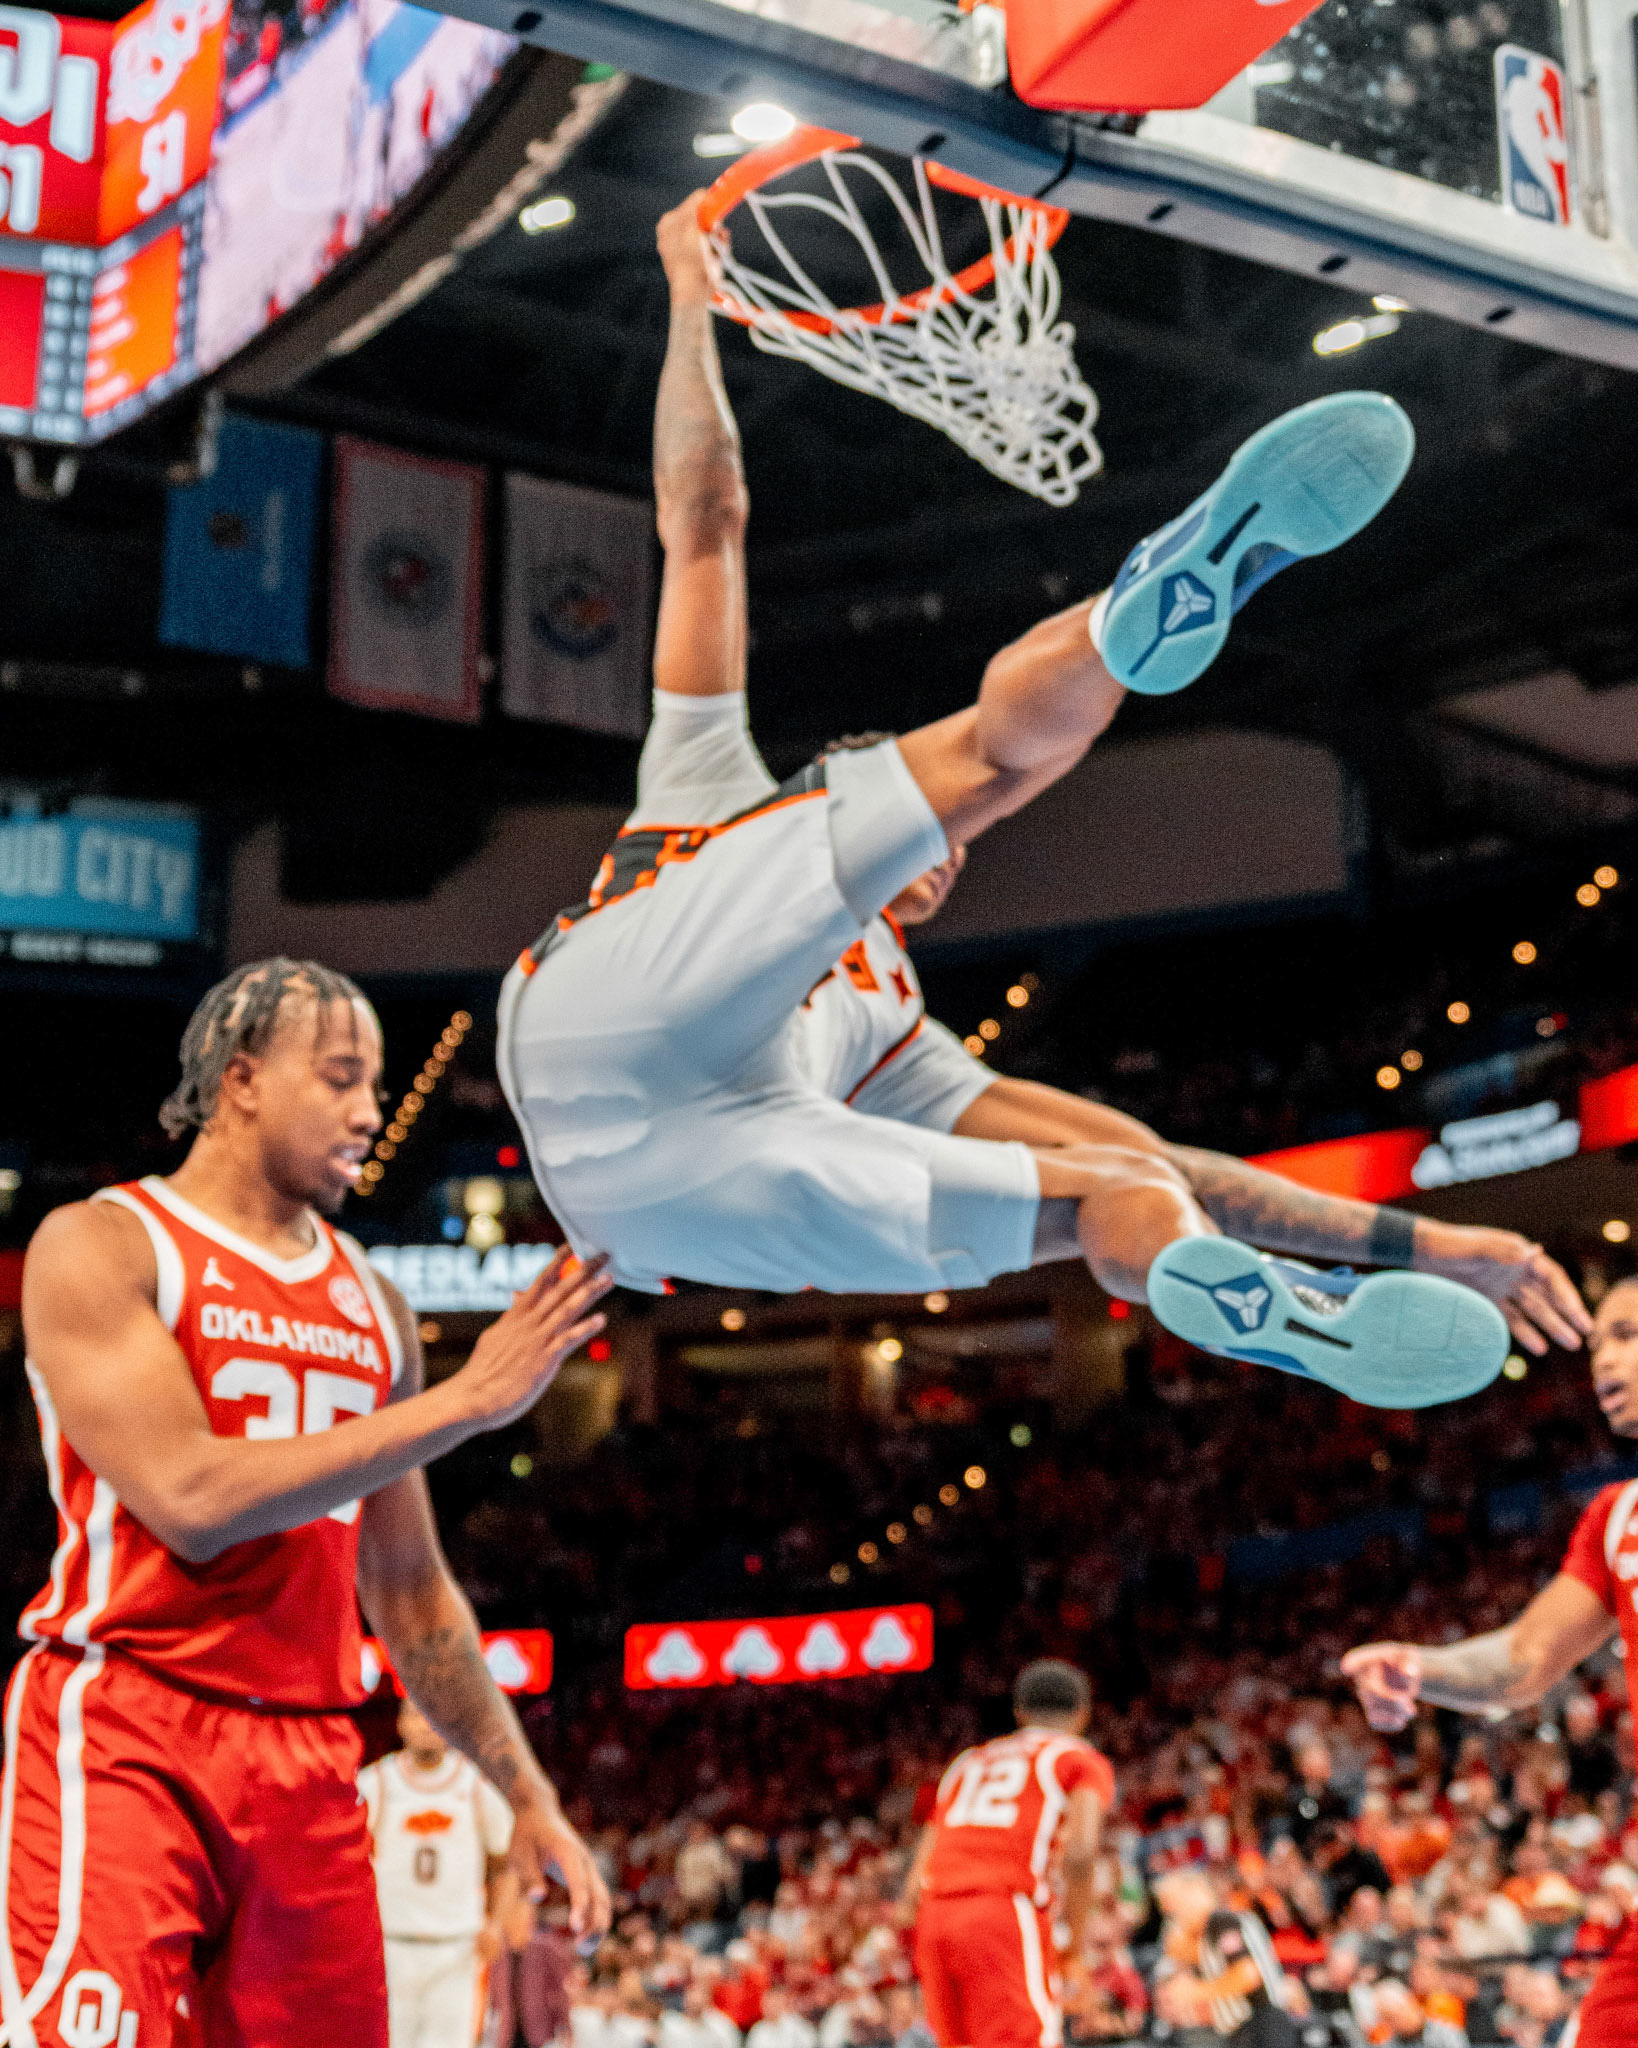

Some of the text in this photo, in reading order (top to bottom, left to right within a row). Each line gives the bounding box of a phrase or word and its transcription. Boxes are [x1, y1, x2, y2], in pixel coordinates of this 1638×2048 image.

[77, 826, 193, 921] CITY
[200, 1303, 384, 1375] OKLAHOMA
[944, 1759, 1029, 1828] 12
